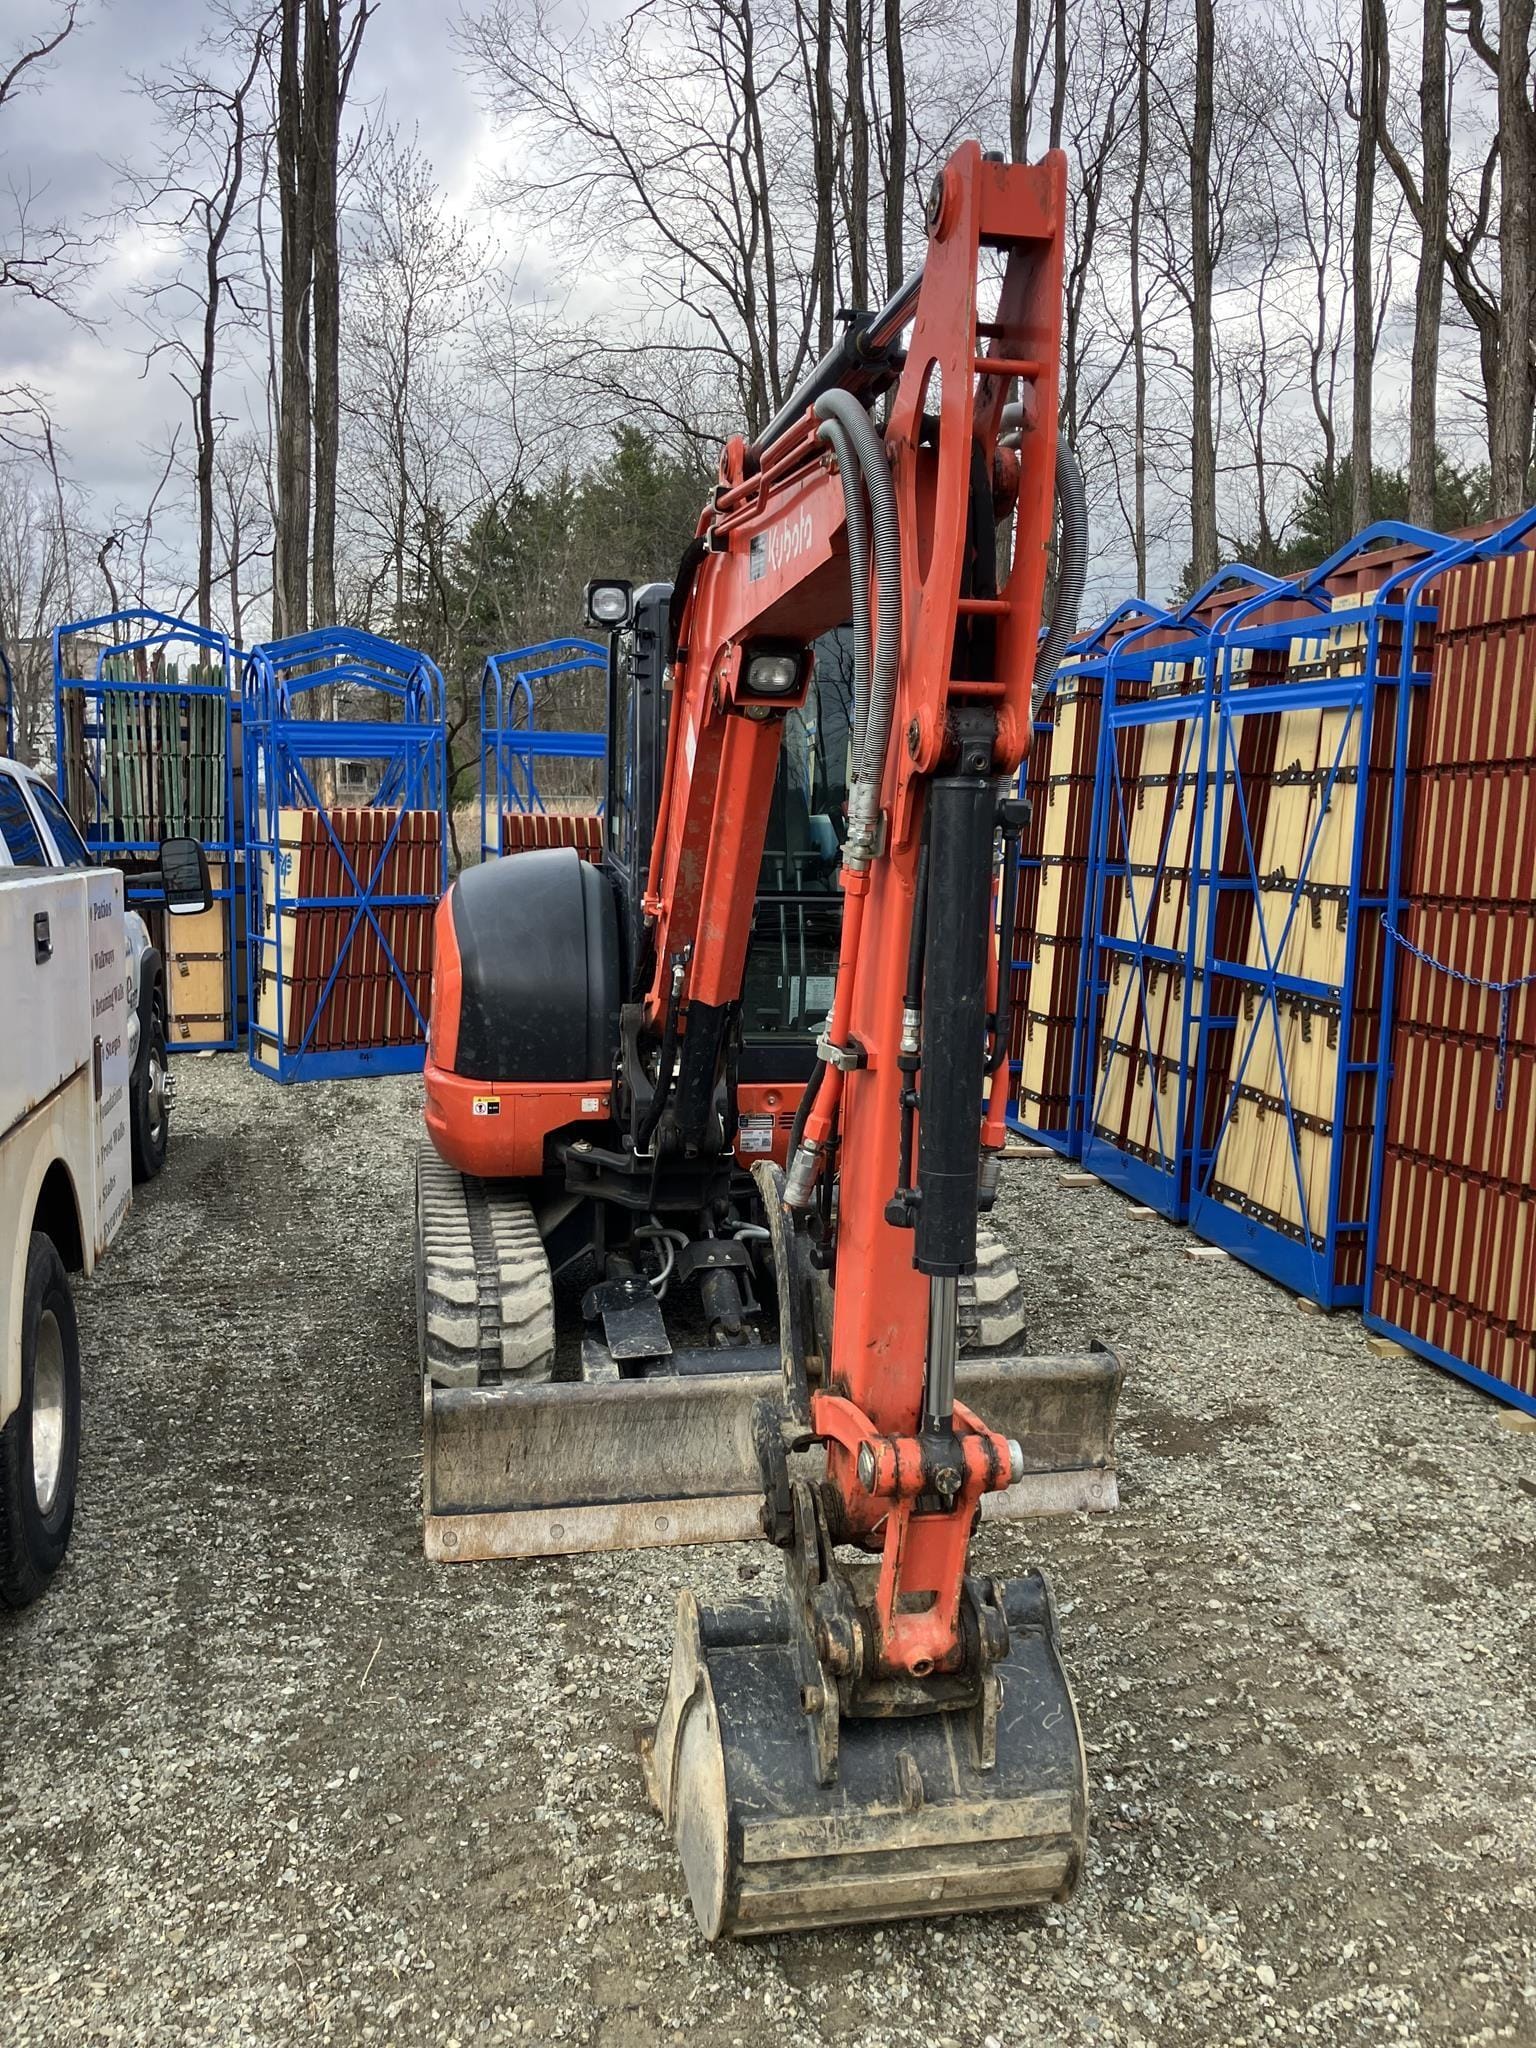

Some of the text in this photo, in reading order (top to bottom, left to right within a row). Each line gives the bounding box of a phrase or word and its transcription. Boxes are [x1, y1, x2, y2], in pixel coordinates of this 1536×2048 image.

[768, 505, 812, 571] Kubota
[93, 901, 112, 921] Patios
[94, 949, 115, 971] Walkways
[105, 1035, 121, 1058] Steps
[102, 1175, 117, 1204] Slabs
